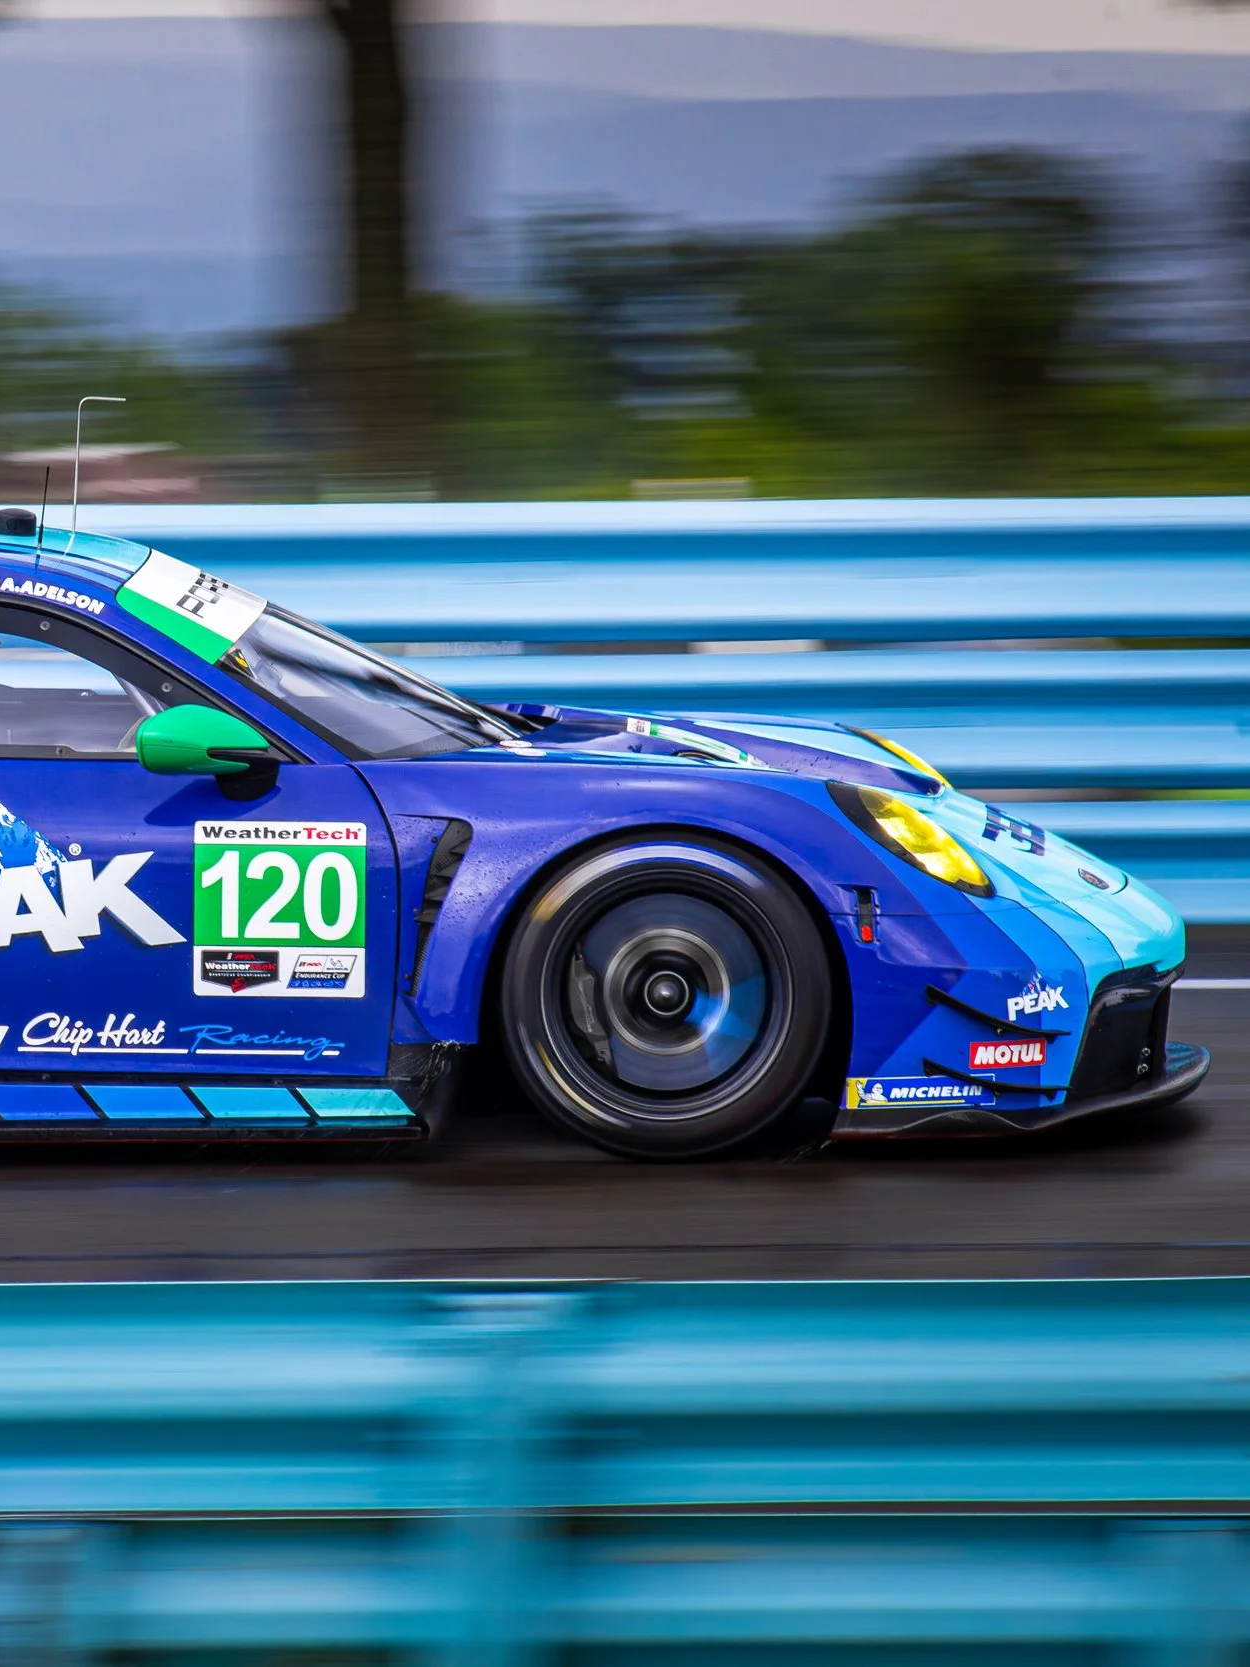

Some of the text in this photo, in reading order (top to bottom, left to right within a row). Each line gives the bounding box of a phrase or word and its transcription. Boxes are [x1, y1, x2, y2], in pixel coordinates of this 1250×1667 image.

[0, 581, 106, 615] A.ADELSON
[202, 826, 359, 840] WeatherTech
[201, 850, 358, 941] 120
[1007, 986, 1069, 1021] PEAK
[21, 1012, 345, 1061] Chip Hart Racing
[974, 1043, 1043, 1066] MOTUL
[890, 1085, 983, 1099] MICHELIN
